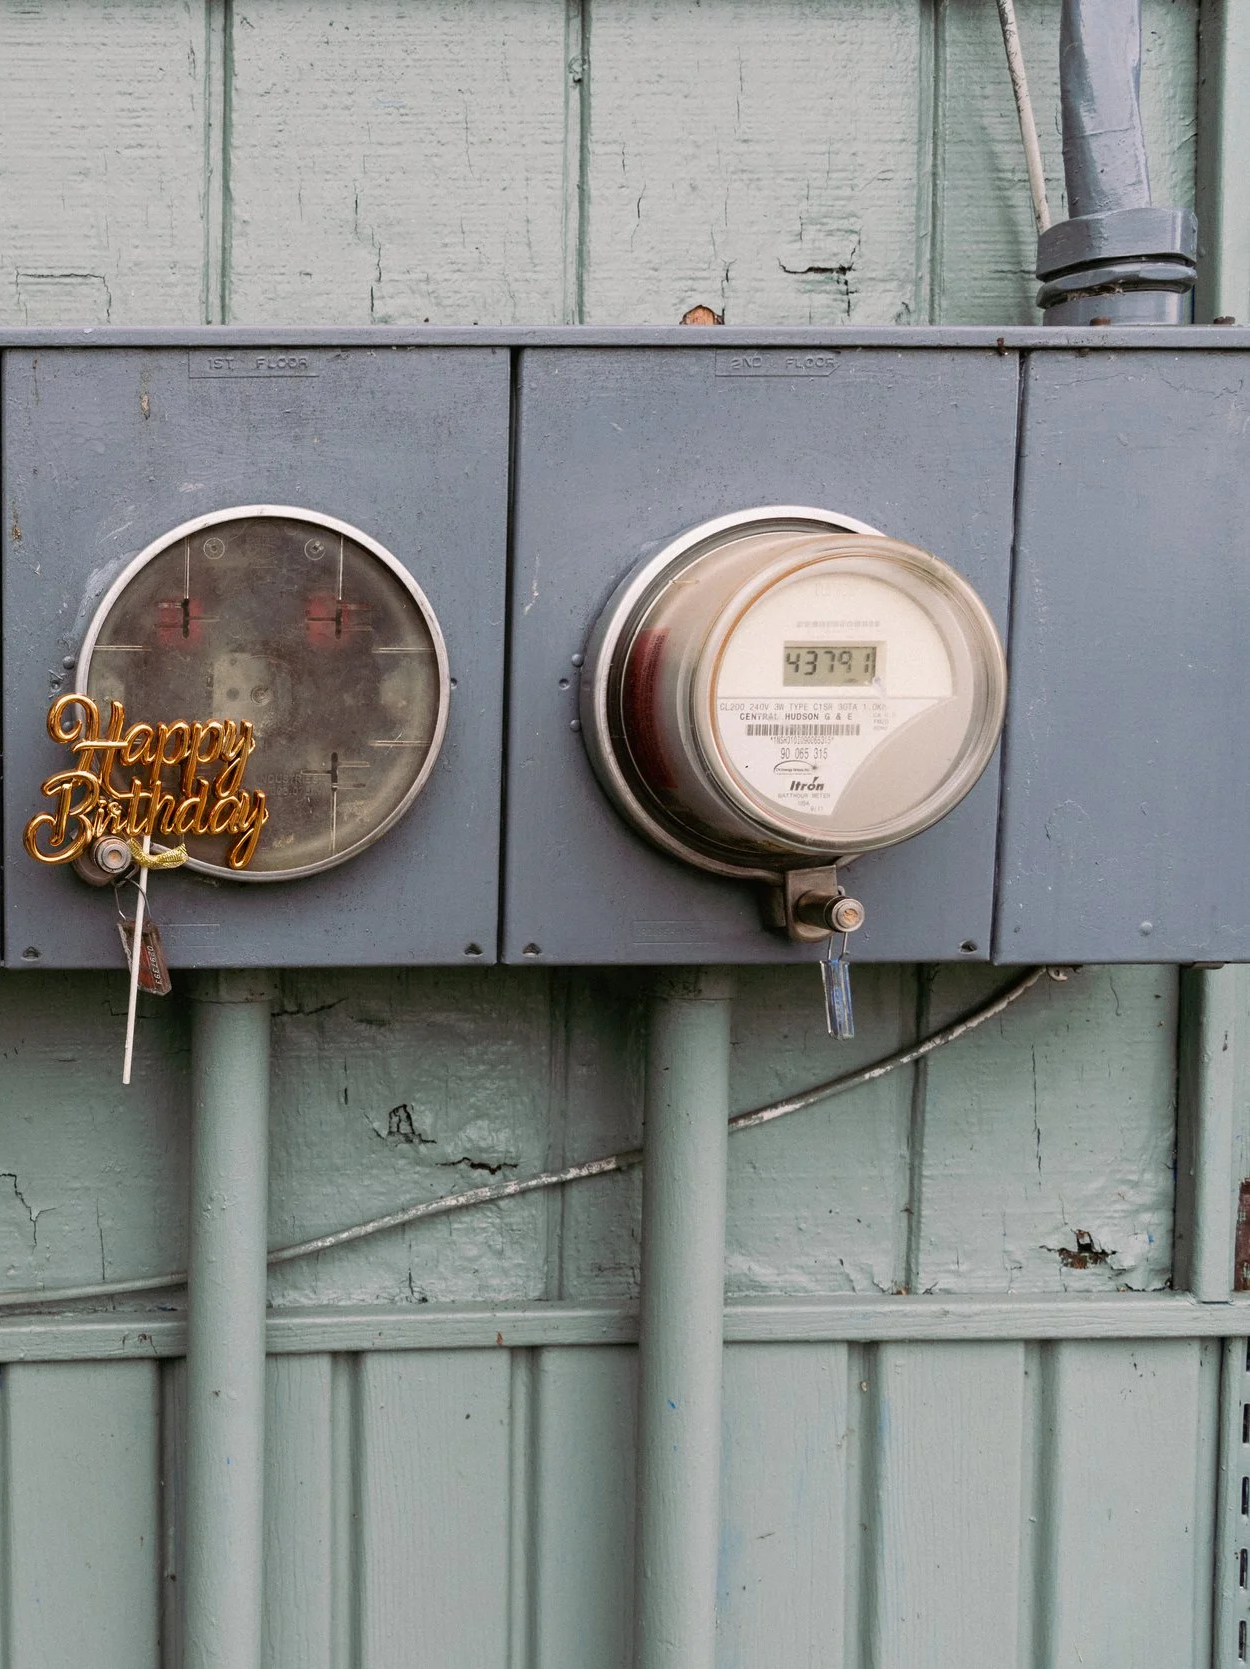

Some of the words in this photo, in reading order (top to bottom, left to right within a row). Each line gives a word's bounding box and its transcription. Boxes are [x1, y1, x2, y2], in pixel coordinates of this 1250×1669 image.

[208, 356, 235, 370] 1ST
[256, 355, 308, 369] FLOOR
[731, 356, 763, 370] 2ND
[785, 355, 835, 369] FLOOR
[785, 650, 871, 676] 43791
[719, 702, 745, 711] CL200
[749, 703, 769, 711] 240V
[789, 703, 808, 711] TYPE
[739, 712, 778, 721] CENTRAL
[784, 712, 819, 721] HUDSON
[824, 712, 830, 721] G
[835, 712, 842, 721] &
[847, 712, 853, 721] E
[47, 692, 256, 800] Happy
[780, 747, 790, 760] 90
[794, 747, 809, 760] 065
[813, 747, 828, 760] 315
[22, 769, 269, 871] Birthday
